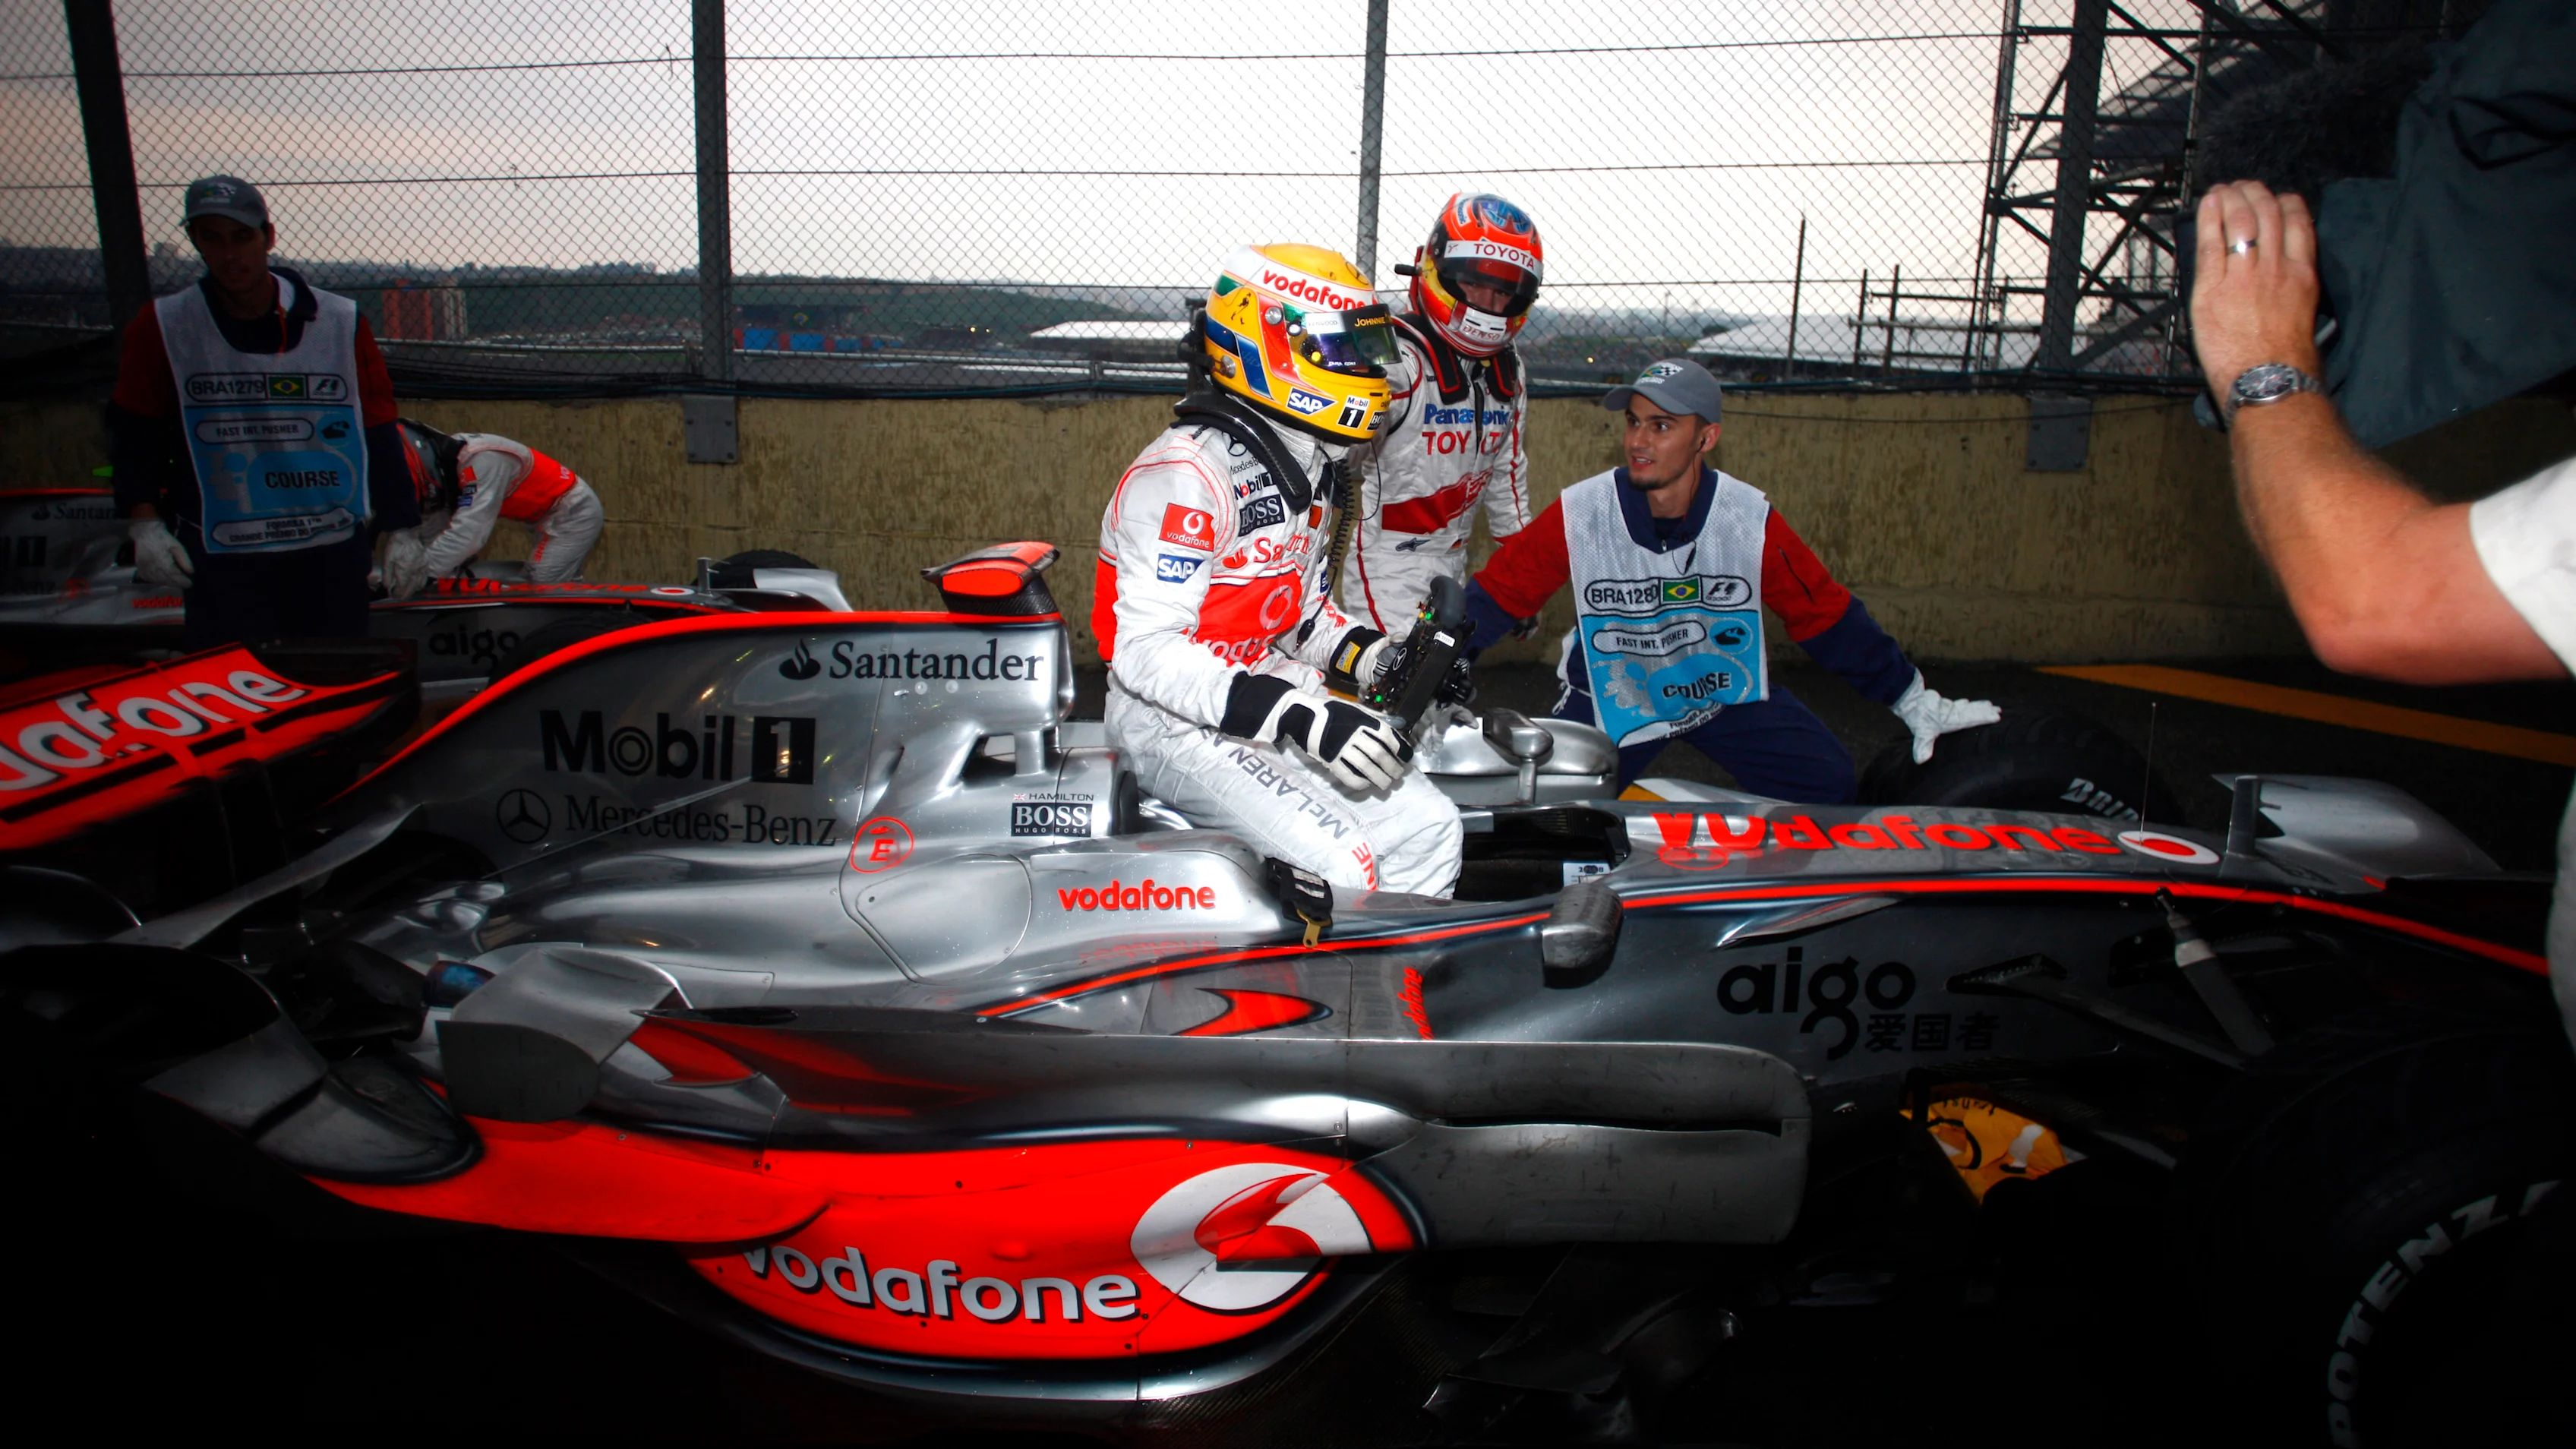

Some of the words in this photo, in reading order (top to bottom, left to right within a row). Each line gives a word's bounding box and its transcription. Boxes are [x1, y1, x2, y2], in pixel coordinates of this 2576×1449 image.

[1474, 243, 1535, 271] TOYOTA
[1354, 316, 1385, 327] JOHNNIE
[1463, 325, 1501, 341] DENSO
[191, 379, 265, 396] BRA1279
[1289, 392, 1324, 412] SAP
[1346, 396, 1368, 408] Mobil
[216, 427, 241, 437] FAST
[261, 424, 299, 435] PUSHER
[1422, 430, 1505, 456] TOYT
[265, 470, 340, 488] COURSE
[54, 503, 116, 520] Santan
[1167, 532, 1210, 548] vodafone
[1158, 558, 1195, 579] SAP
[132, 595, 184, 608] vodafo
[1616, 636, 1638, 649] FAST
[1640, 639, 1659, 649] INT.
[829, 639, 1045, 681] Santander
[1662, 671, 1732, 700] COURSE
[0, 669, 308, 792] dafone
[540, 710, 733, 781] Mobil
[1028, 792, 1094, 802] HAMILTON
[1227, 746, 1351, 840] McLAREN
[565, 794, 837, 848] Mercedes-Benz
[1014, 805, 1088, 827] BOSS
[1056, 878, 1216, 911] vodafone
[1397, 967, 1435, 1040] odafone
[1718, 946, 1916, 1061] aigo
[1864, 1013, 2000, 1053] 爱国者
[737, 1239, 1139, 1324] vodafone
